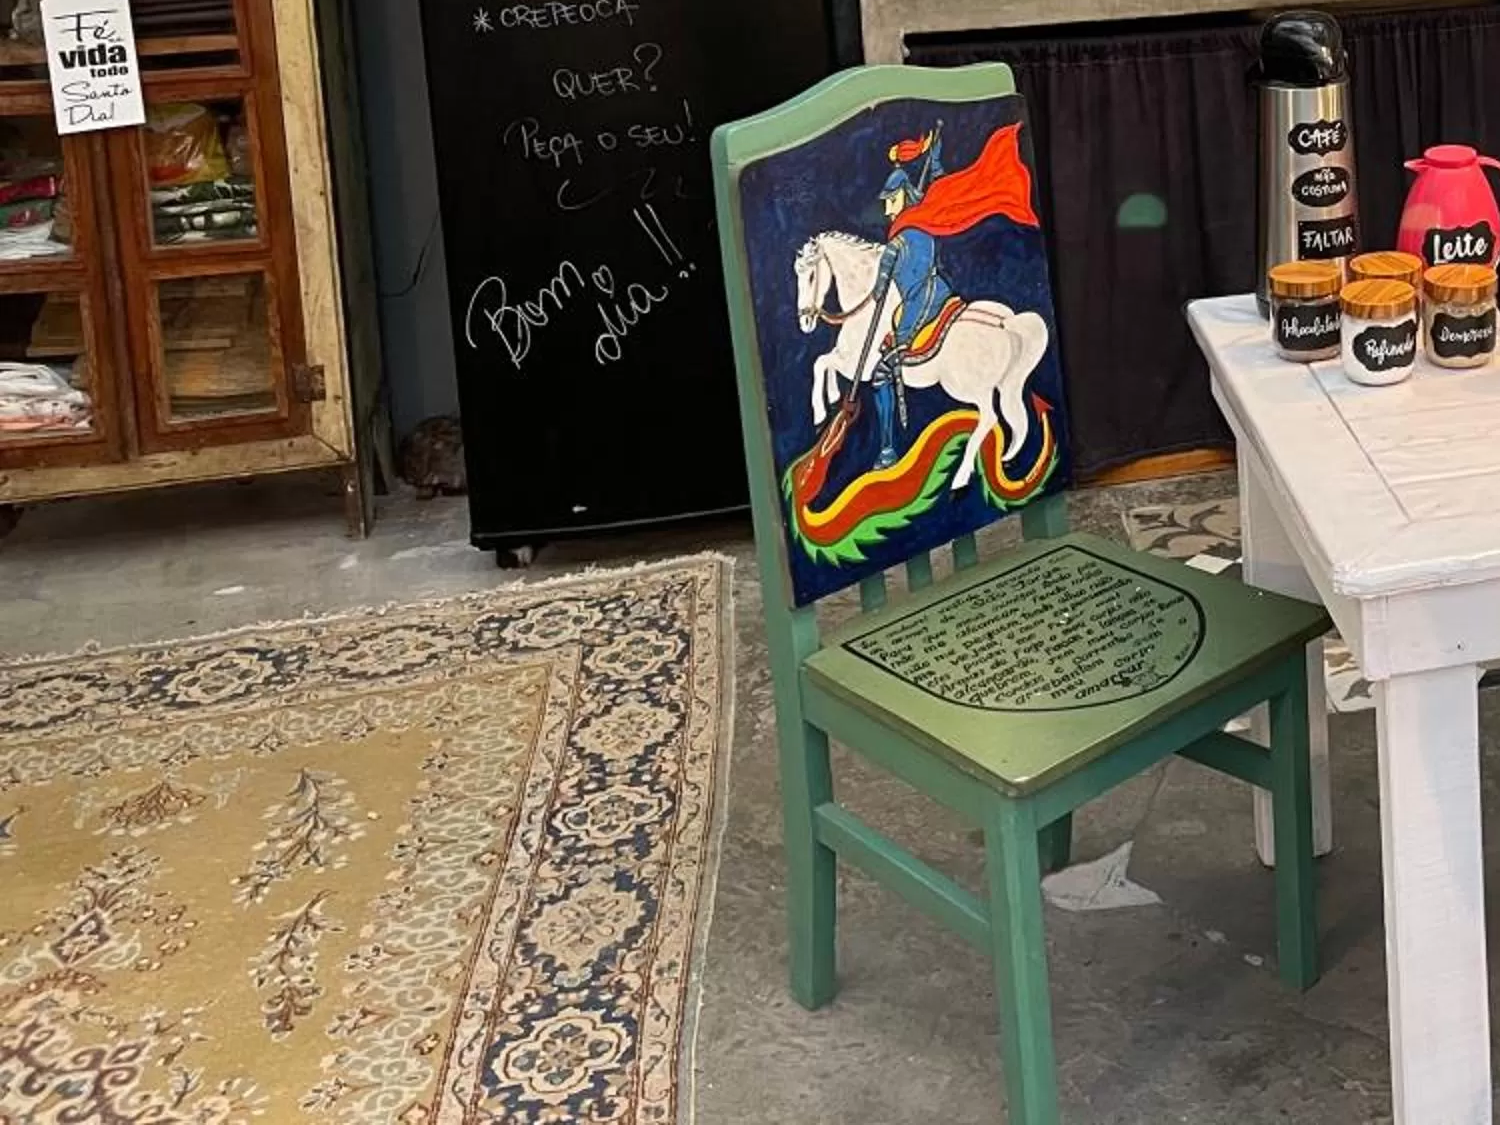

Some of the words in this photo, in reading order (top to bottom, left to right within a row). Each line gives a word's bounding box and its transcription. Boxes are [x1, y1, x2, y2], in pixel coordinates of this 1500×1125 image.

[58, 43, 127, 70] vida
[89, 66, 129, 78] todo
[552, 43, 663, 100] QUER?
[61, 81, 132, 103] Santo
[628, 99, 697, 149] SEU!
[1298, 122, 1341, 148] CAFÉ
[1302, 226, 1354, 252] FALTAR
[1433, 232, 1488, 265] Leite
[465, 260, 586, 370] Bom
